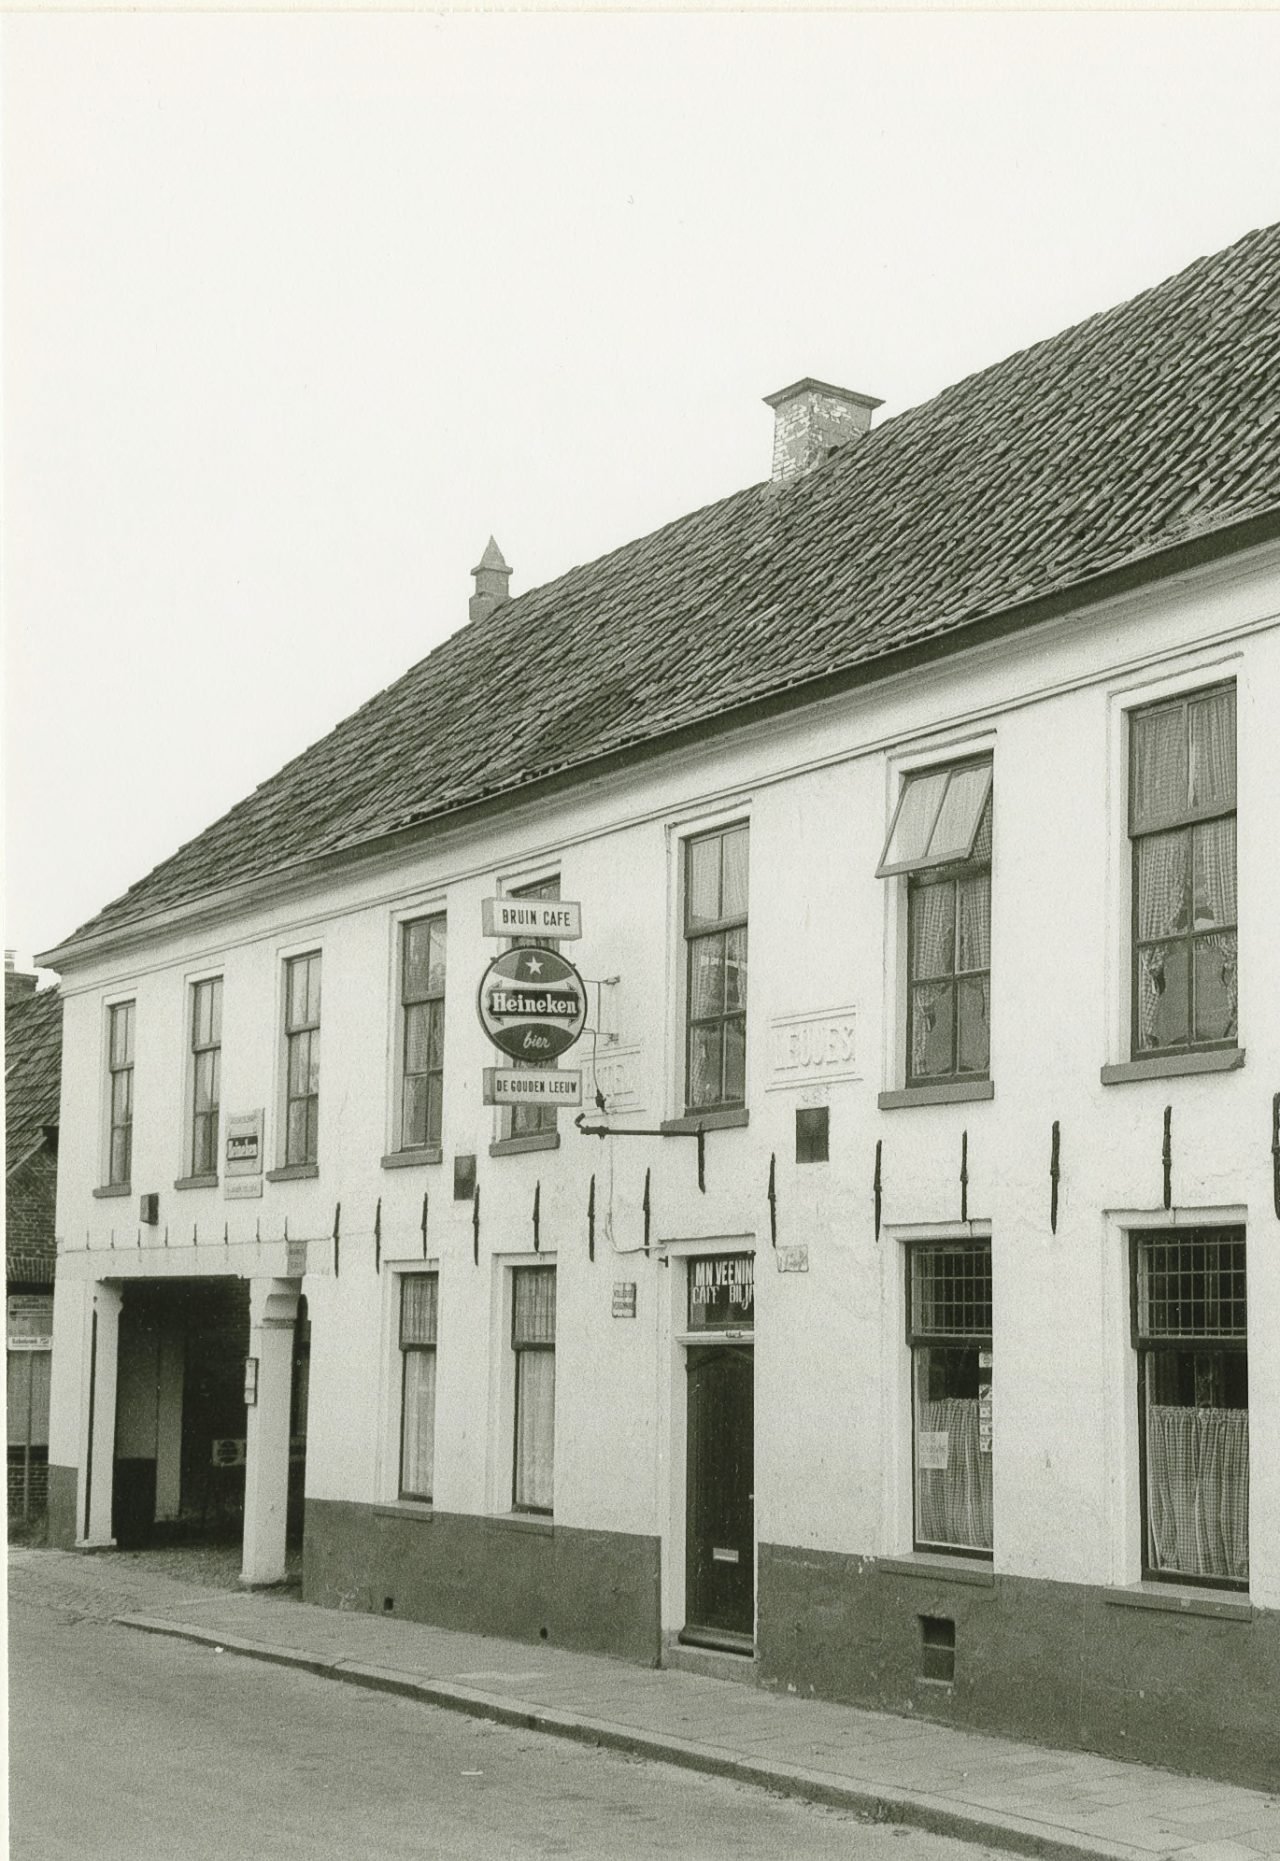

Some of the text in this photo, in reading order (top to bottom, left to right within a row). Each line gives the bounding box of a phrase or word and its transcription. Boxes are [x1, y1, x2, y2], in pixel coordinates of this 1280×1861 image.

[502, 909, 570, 927] BRUIN CAFE
[492, 992, 577, 1014] Heineken
[523, 1031, 550, 1049] bier
[496, 1079, 577, 1094] DE GOUDEN LEEUW
